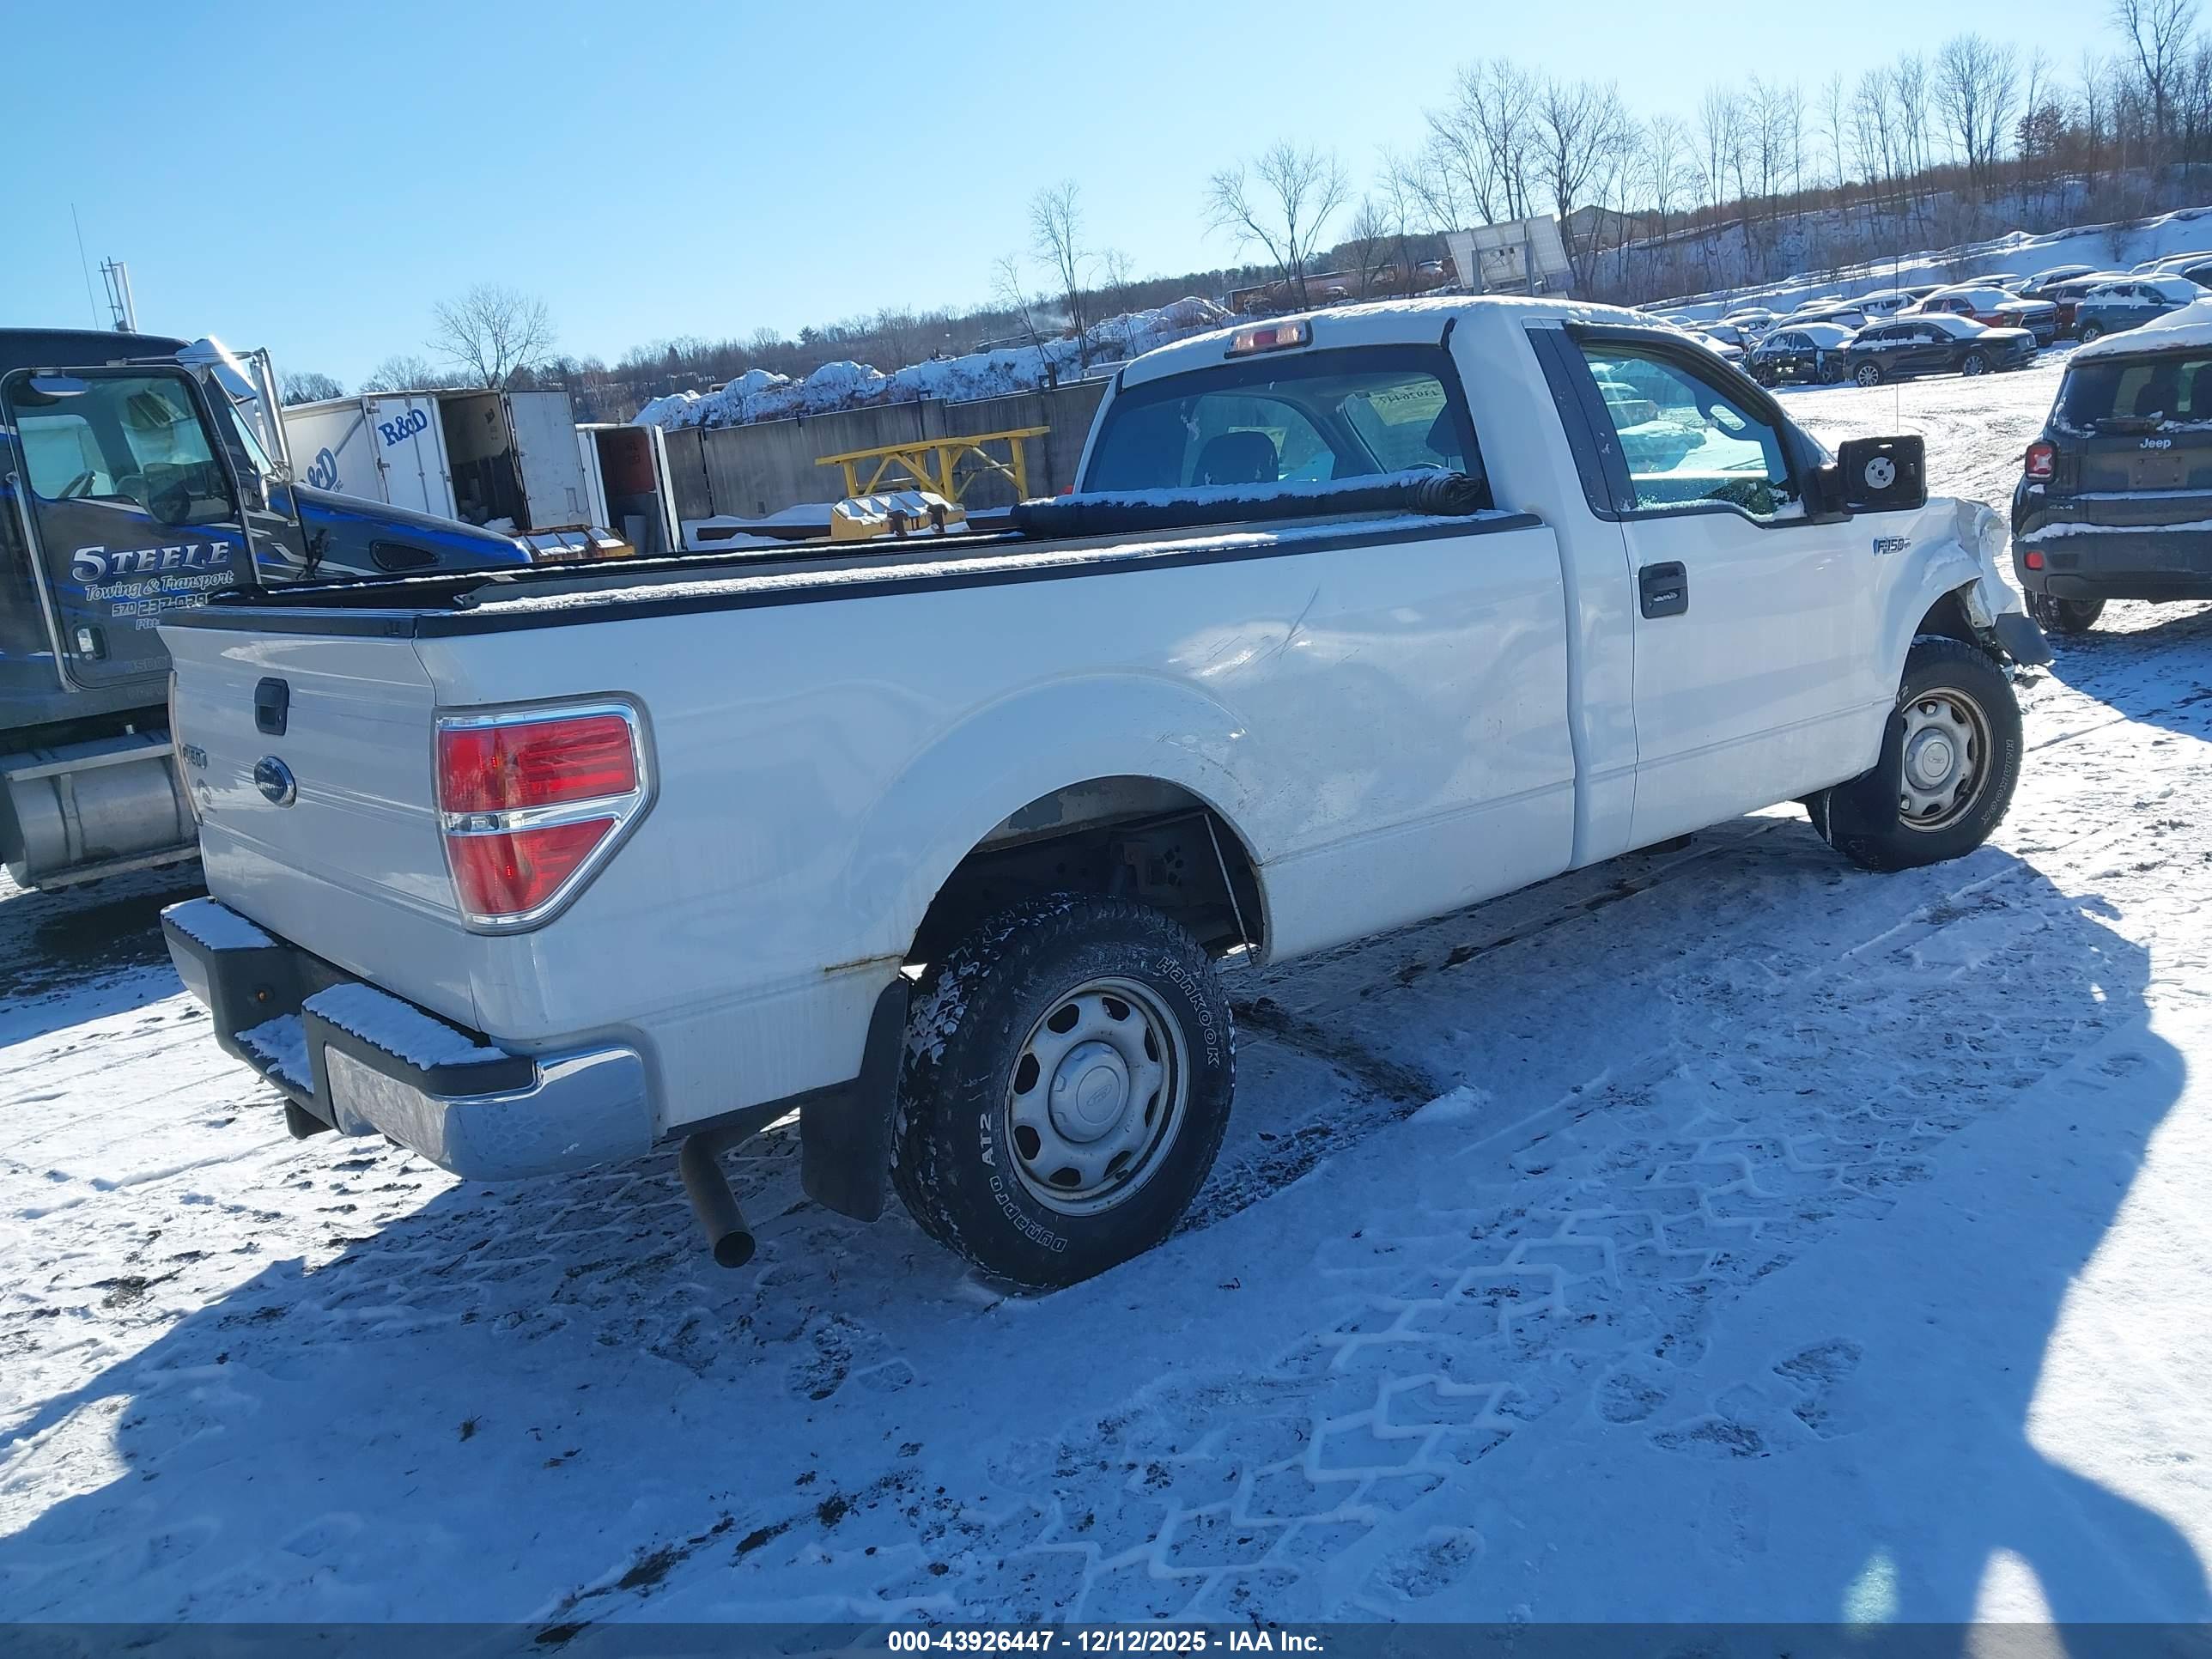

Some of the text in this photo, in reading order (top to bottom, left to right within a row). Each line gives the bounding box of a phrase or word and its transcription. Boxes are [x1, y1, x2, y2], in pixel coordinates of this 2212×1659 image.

[378, 409, 428, 447] R&D
[2139, 438, 2172, 449] Jeep
[72, 540, 230, 582] STEELE
[1877, 537, 1905, 552] F-150
[85, 569, 234, 602] Towing & Transport
[112, 592, 216, 617] 570 237-039
[989, 1174, 1069, 1254] Dynapro
